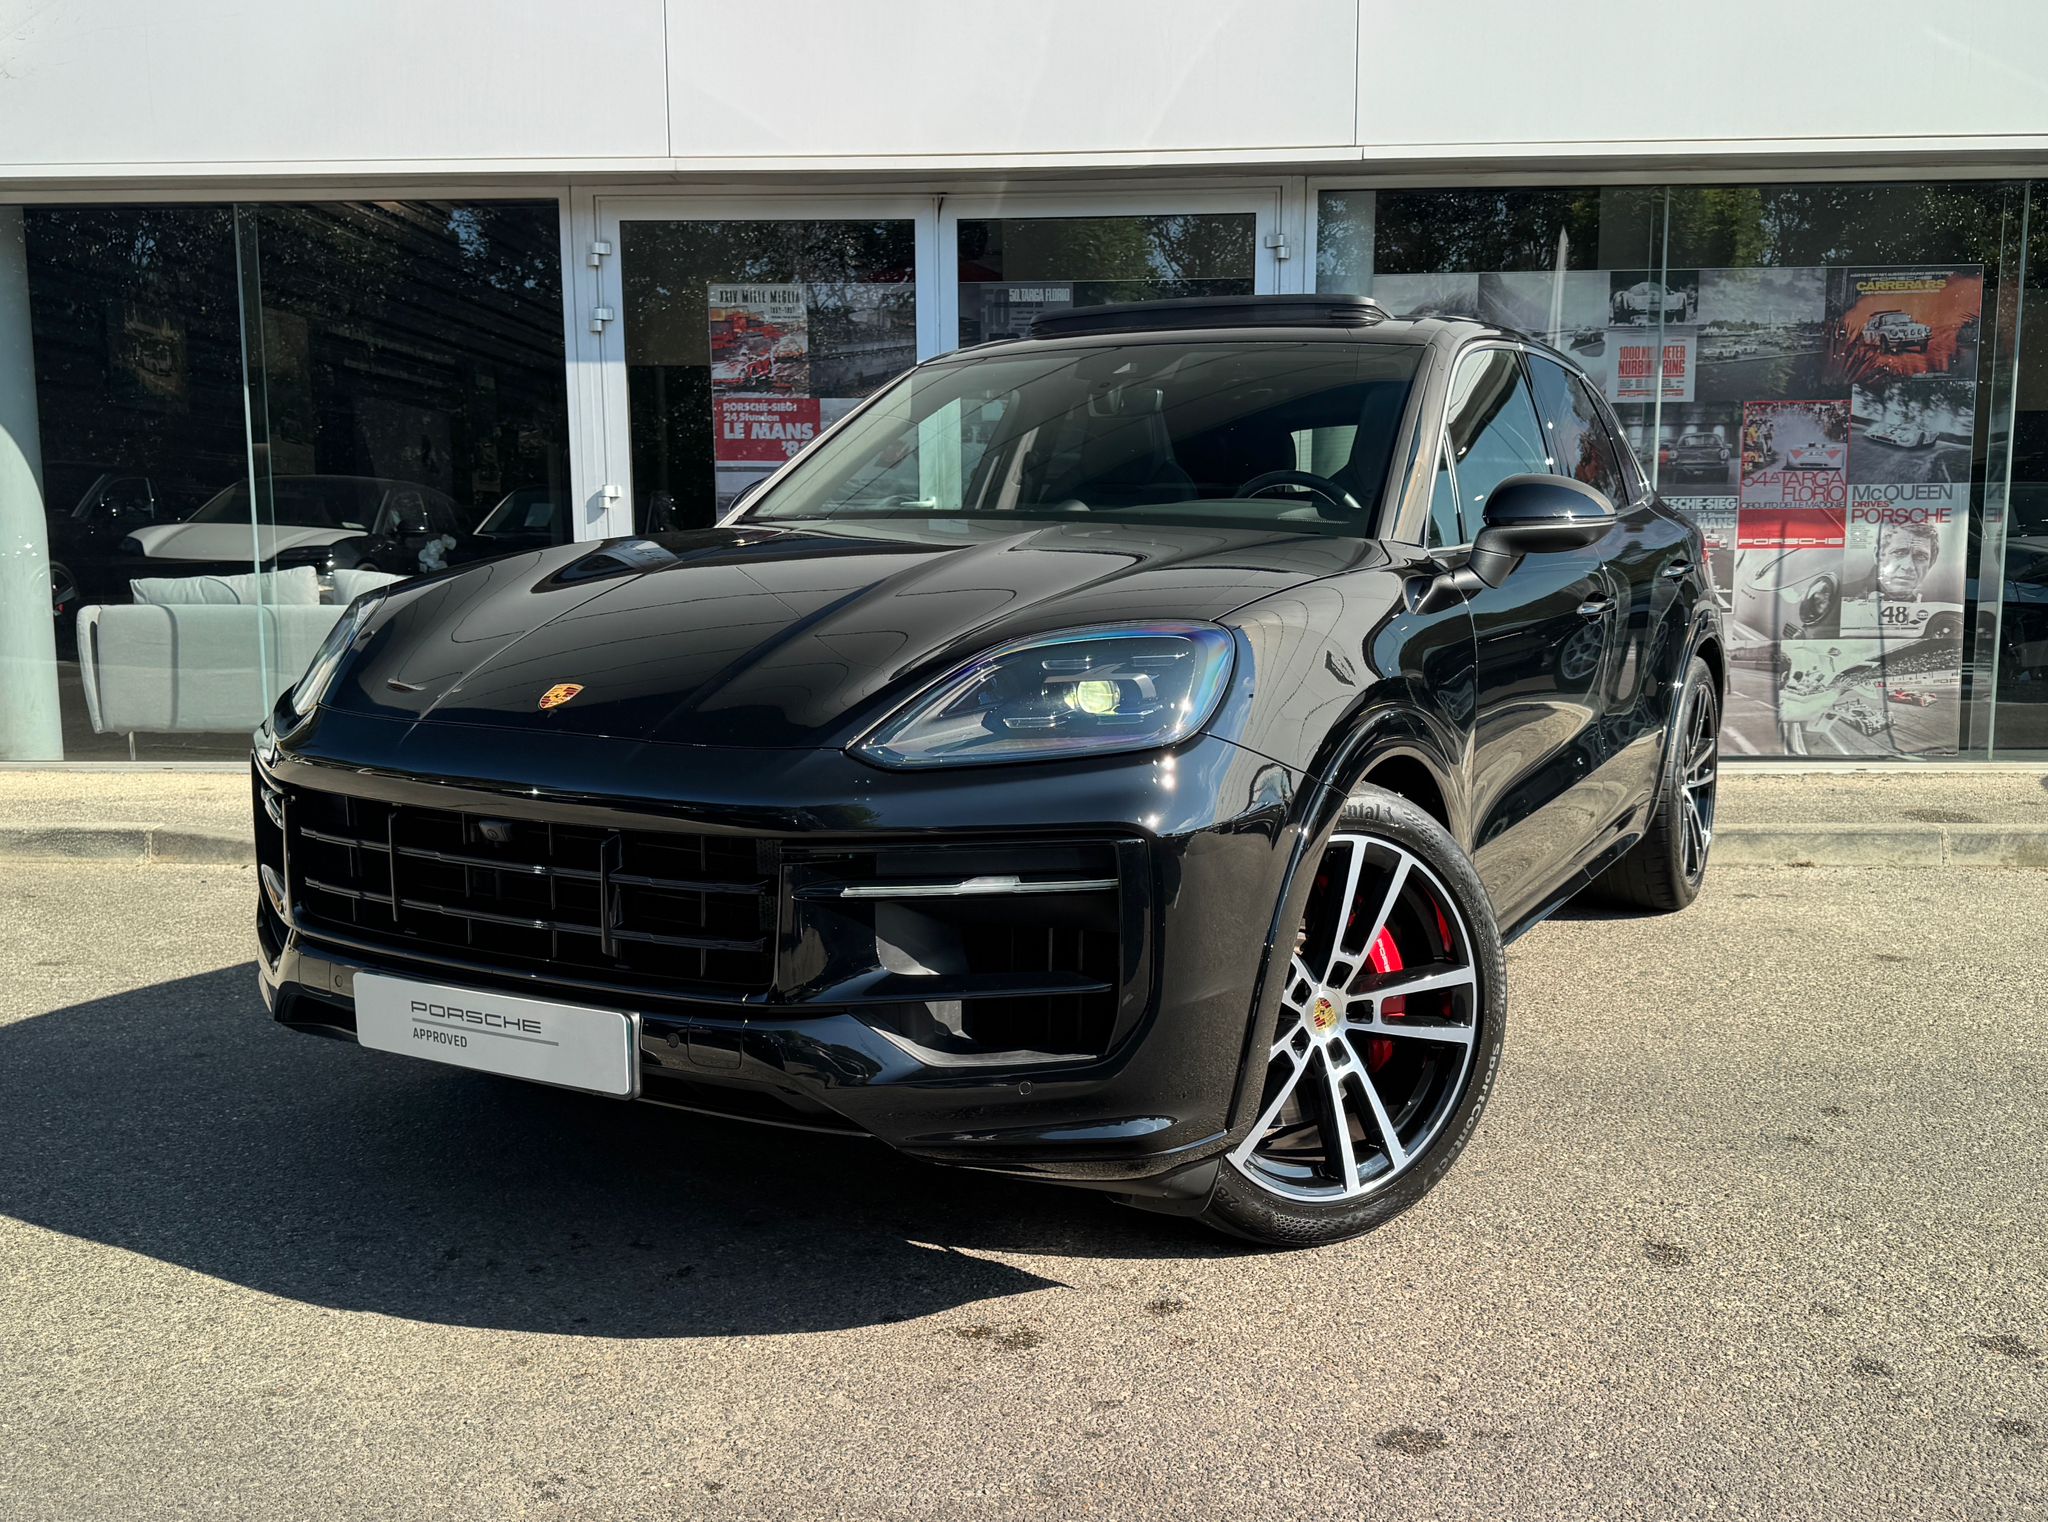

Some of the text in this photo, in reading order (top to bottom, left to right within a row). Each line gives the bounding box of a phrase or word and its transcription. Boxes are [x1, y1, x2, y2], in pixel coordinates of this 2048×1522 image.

[1856, 279, 1948, 291] CARRERA RS
[719, 290, 738, 303] XXIV
[770, 290, 800, 303] MIGLIA
[1021, 288, 1044, 301] TARGA
[1045, 288, 1070, 301] FLORIO
[724, 413, 779, 421] 24 Stunden
[724, 423, 814, 439] LE MANS
[1779, 471, 1845, 486] TARGA
[1782, 486, 1844, 501] FLORIO
[1853, 485, 1952, 500] McQUEEN
[1852, 508, 1952, 525] PORSCHE
[1880, 606, 1907, 624] 48
[411, 1001, 541, 1034] PORSCHE
[413, 1027, 467, 1048] APPROVED
[1433, 1042, 1500, 1176] SportContact
